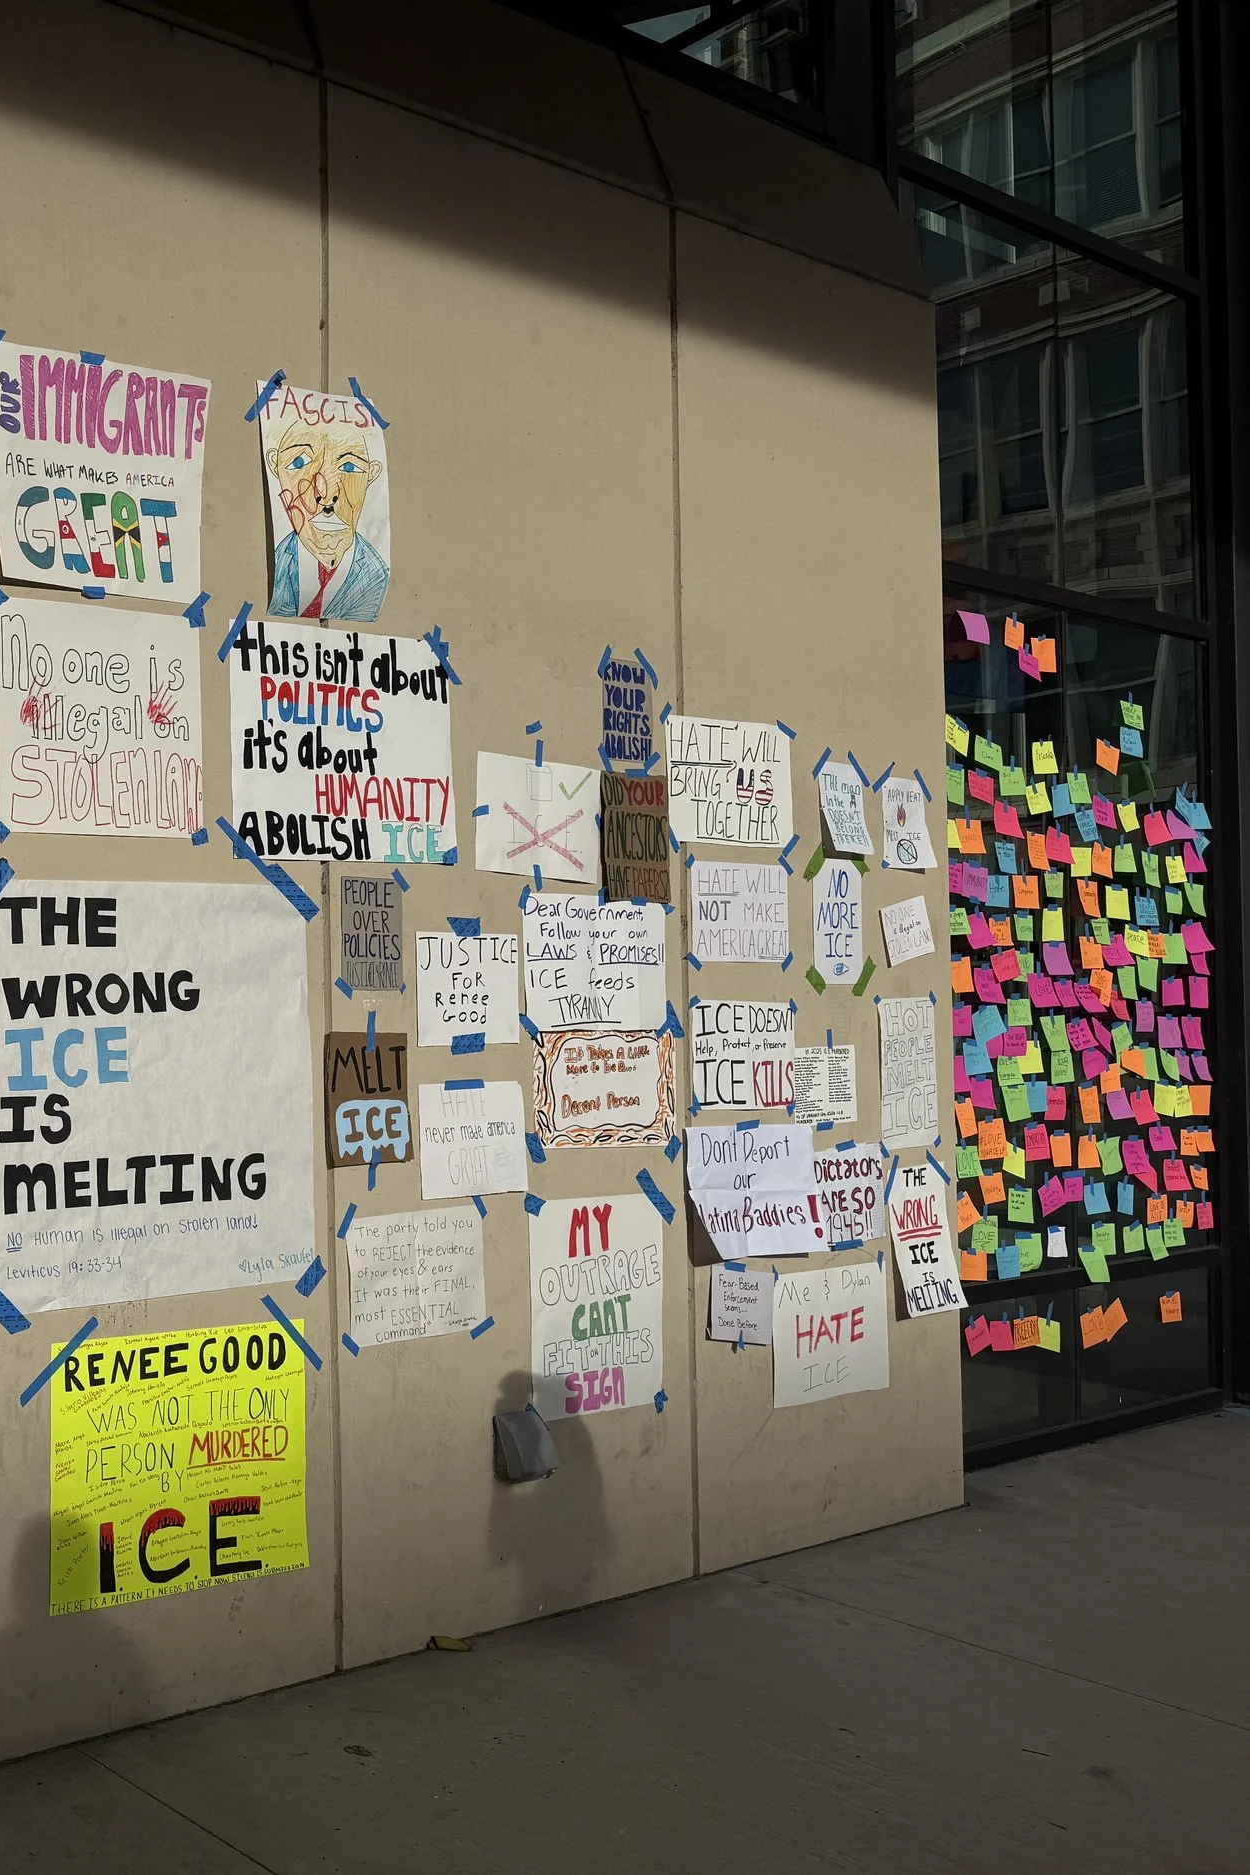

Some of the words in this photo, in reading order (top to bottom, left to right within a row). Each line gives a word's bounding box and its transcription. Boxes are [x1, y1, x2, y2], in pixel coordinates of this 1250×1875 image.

[19, 353, 209, 461] IMMIGRANTS
[5, 451, 37, 479] ARE
[43, 461, 74, 481] WHAT
[77, 462, 119, 487] MAKES
[125, 471, 175, 489] AMERICA
[14, 486, 179, 584] GREAT
[603, 662, 645, 685] KNOW
[259, 677, 385, 734] POLITICS
[604, 684, 646, 712] YOUR
[29, 692, 145, 765] illegal
[157, 697, 191, 742] on
[313, 774, 452, 826] HUMANITY
[602, 773, 624, 807] DID
[623, 777, 665, 806] YOUR
[670, 765, 722, 800] BRING
[736, 767, 774, 806] US
[606, 810, 668, 863] ANCESTORS
[690, 798, 781, 841] TOGETHER
[237, 811, 372, 862] ABOLISH
[381, 822, 447, 864] ICE
[344, 879, 395, 909] PEOPLE
[698, 869, 741, 895] HATE
[746, 869, 787, 895] WILL
[828, 868, 849, 899] NO
[353, 910, 390, 934] OVER
[523, 897, 562, 918] Dear
[699, 901, 731, 922] NOT
[743, 902, 785, 924] MAKE
[817, 901, 859, 932] MORE
[343, 933, 401, 961] POLICIES
[539, 921, 581, 940] Follow
[588, 926, 618, 943] your
[628, 928, 649, 940] own
[696, 928, 757, 958] AMERICA
[757, 929, 789, 958] GREAT
[825, 932, 853, 959] ICE
[418, 936, 517, 971] JUSTICE
[1, 970, 201, 1020] WRONG
[530, 969, 568, 989] ICE
[587, 969, 636, 990] feeds
[435, 992, 489, 1008] Renee
[548, 993, 616, 1024] TYRANNY
[884, 1000, 932, 1036] HOT
[4, 1026, 130, 1092] ICE
[884, 1034, 934, 1065] PEOPLE
[331, 1045, 406, 1094] MELT
[695, 1058, 747, 1107] ICE
[752, 1059, 795, 1108] KILLS
[886, 1057, 934, 1092] MELT
[606, 1091, 641, 1110] Person
[882, 1084, 938, 1140] ICE
[342, 1105, 402, 1143] ICE
[424, 1121, 456, 1143] never
[460, 1123, 483, 1140] made
[3, 1152, 267, 1216] MELTING
[814, 1156, 884, 1184] Dictators
[902, 1168, 927, 1188] THE
[892, 1195, 939, 1230] WRONG
[568, 1203, 613, 1258] MY
[6, 1263, 61, 1280] Leviticus
[86, 1256, 123, 1273] 33-34
[354, 1244, 367, 1258] to
[372, 1243, 412, 1262] REJECT
[415, 1243, 434, 1258] the
[435, 1241, 476, 1256] evidence
[909, 1241, 939, 1265] ICE
[392, 1266, 415, 1280] eyes
[417, 1258, 429, 1276] &
[431, 1264, 454, 1276] ears
[538, 1244, 661, 1307] OUTRAGE
[354, 1287, 368, 1304] It
[374, 1285, 399, 1300] was
[402, 1284, 430, 1299] their
[906, 1278, 960, 1314] MELTING
[354, 1305, 387, 1325] most
[390, 1300, 460, 1327] ESSENTIAL
[795, 1305, 865, 1358] HATE
[64, 1342, 189, 1393] RENEE
[198, 1332, 288, 1374] GOOD
[564, 1365, 626, 1415] SIGN
[86, 1402, 138, 1434] WAS
[151, 1394, 195, 1428] NOT
[204, 1387, 247, 1421] THE
[248, 1387, 291, 1422] ONLY
[85, 1442, 176, 1484] PERSON
[188, 1425, 290, 1467] MURDERED
[161, 1469, 186, 1494] BY
